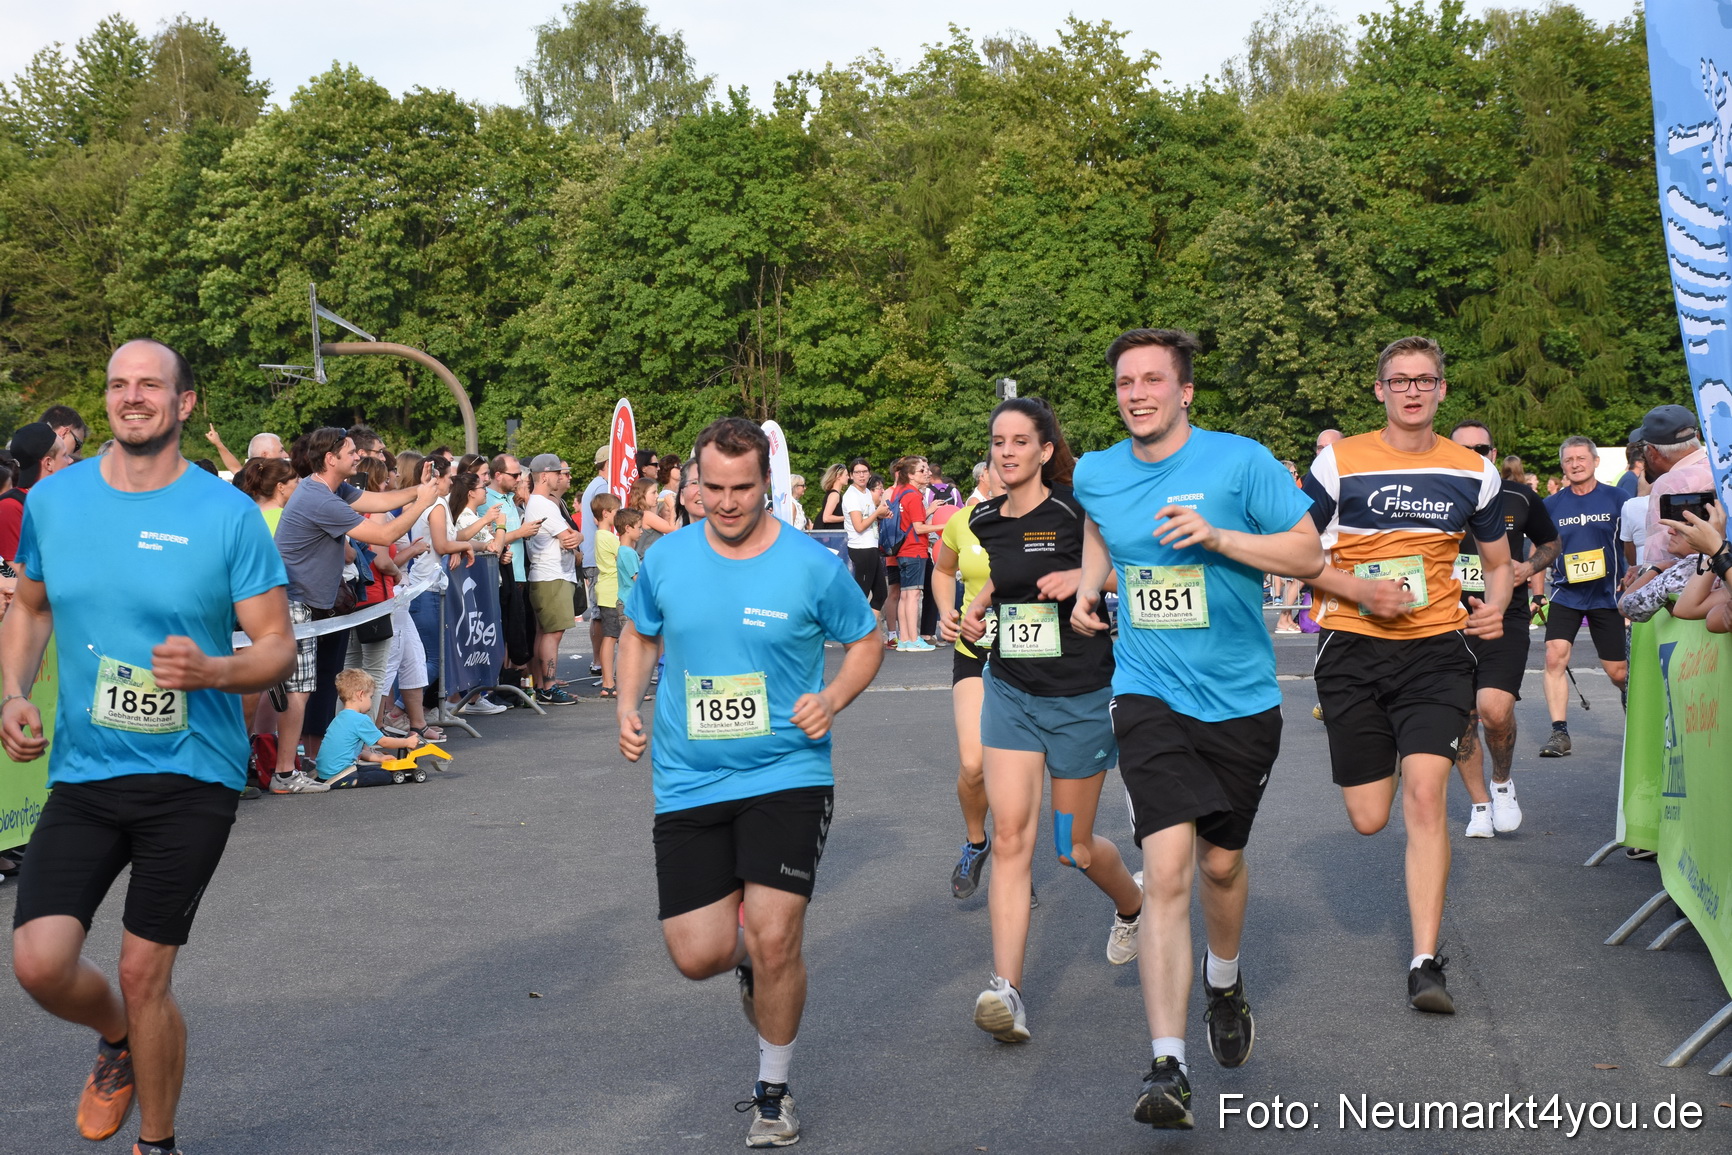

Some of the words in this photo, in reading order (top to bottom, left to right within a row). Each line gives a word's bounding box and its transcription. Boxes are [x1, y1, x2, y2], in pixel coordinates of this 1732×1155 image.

[1384, 496, 1454, 512] Fischer
[1390, 511, 1449, 520] AUTOMOBILE
[1559, 516, 1580, 527] EURO
[1586, 513, 1611, 522] POLES
[149, 531, 189, 545] PFLEIDERER
[1573, 561, 1596, 574] 707
[1136, 588, 1192, 611] 1851
[751, 608, 789, 620] PFLEIDERER
[1008, 624, 1042, 642] 137
[107, 685, 176, 716] 1852
[108, 710, 141, 722] Gebhardt
[143, 714, 172, 722] Michael
[696, 697, 756, 721] 1859
